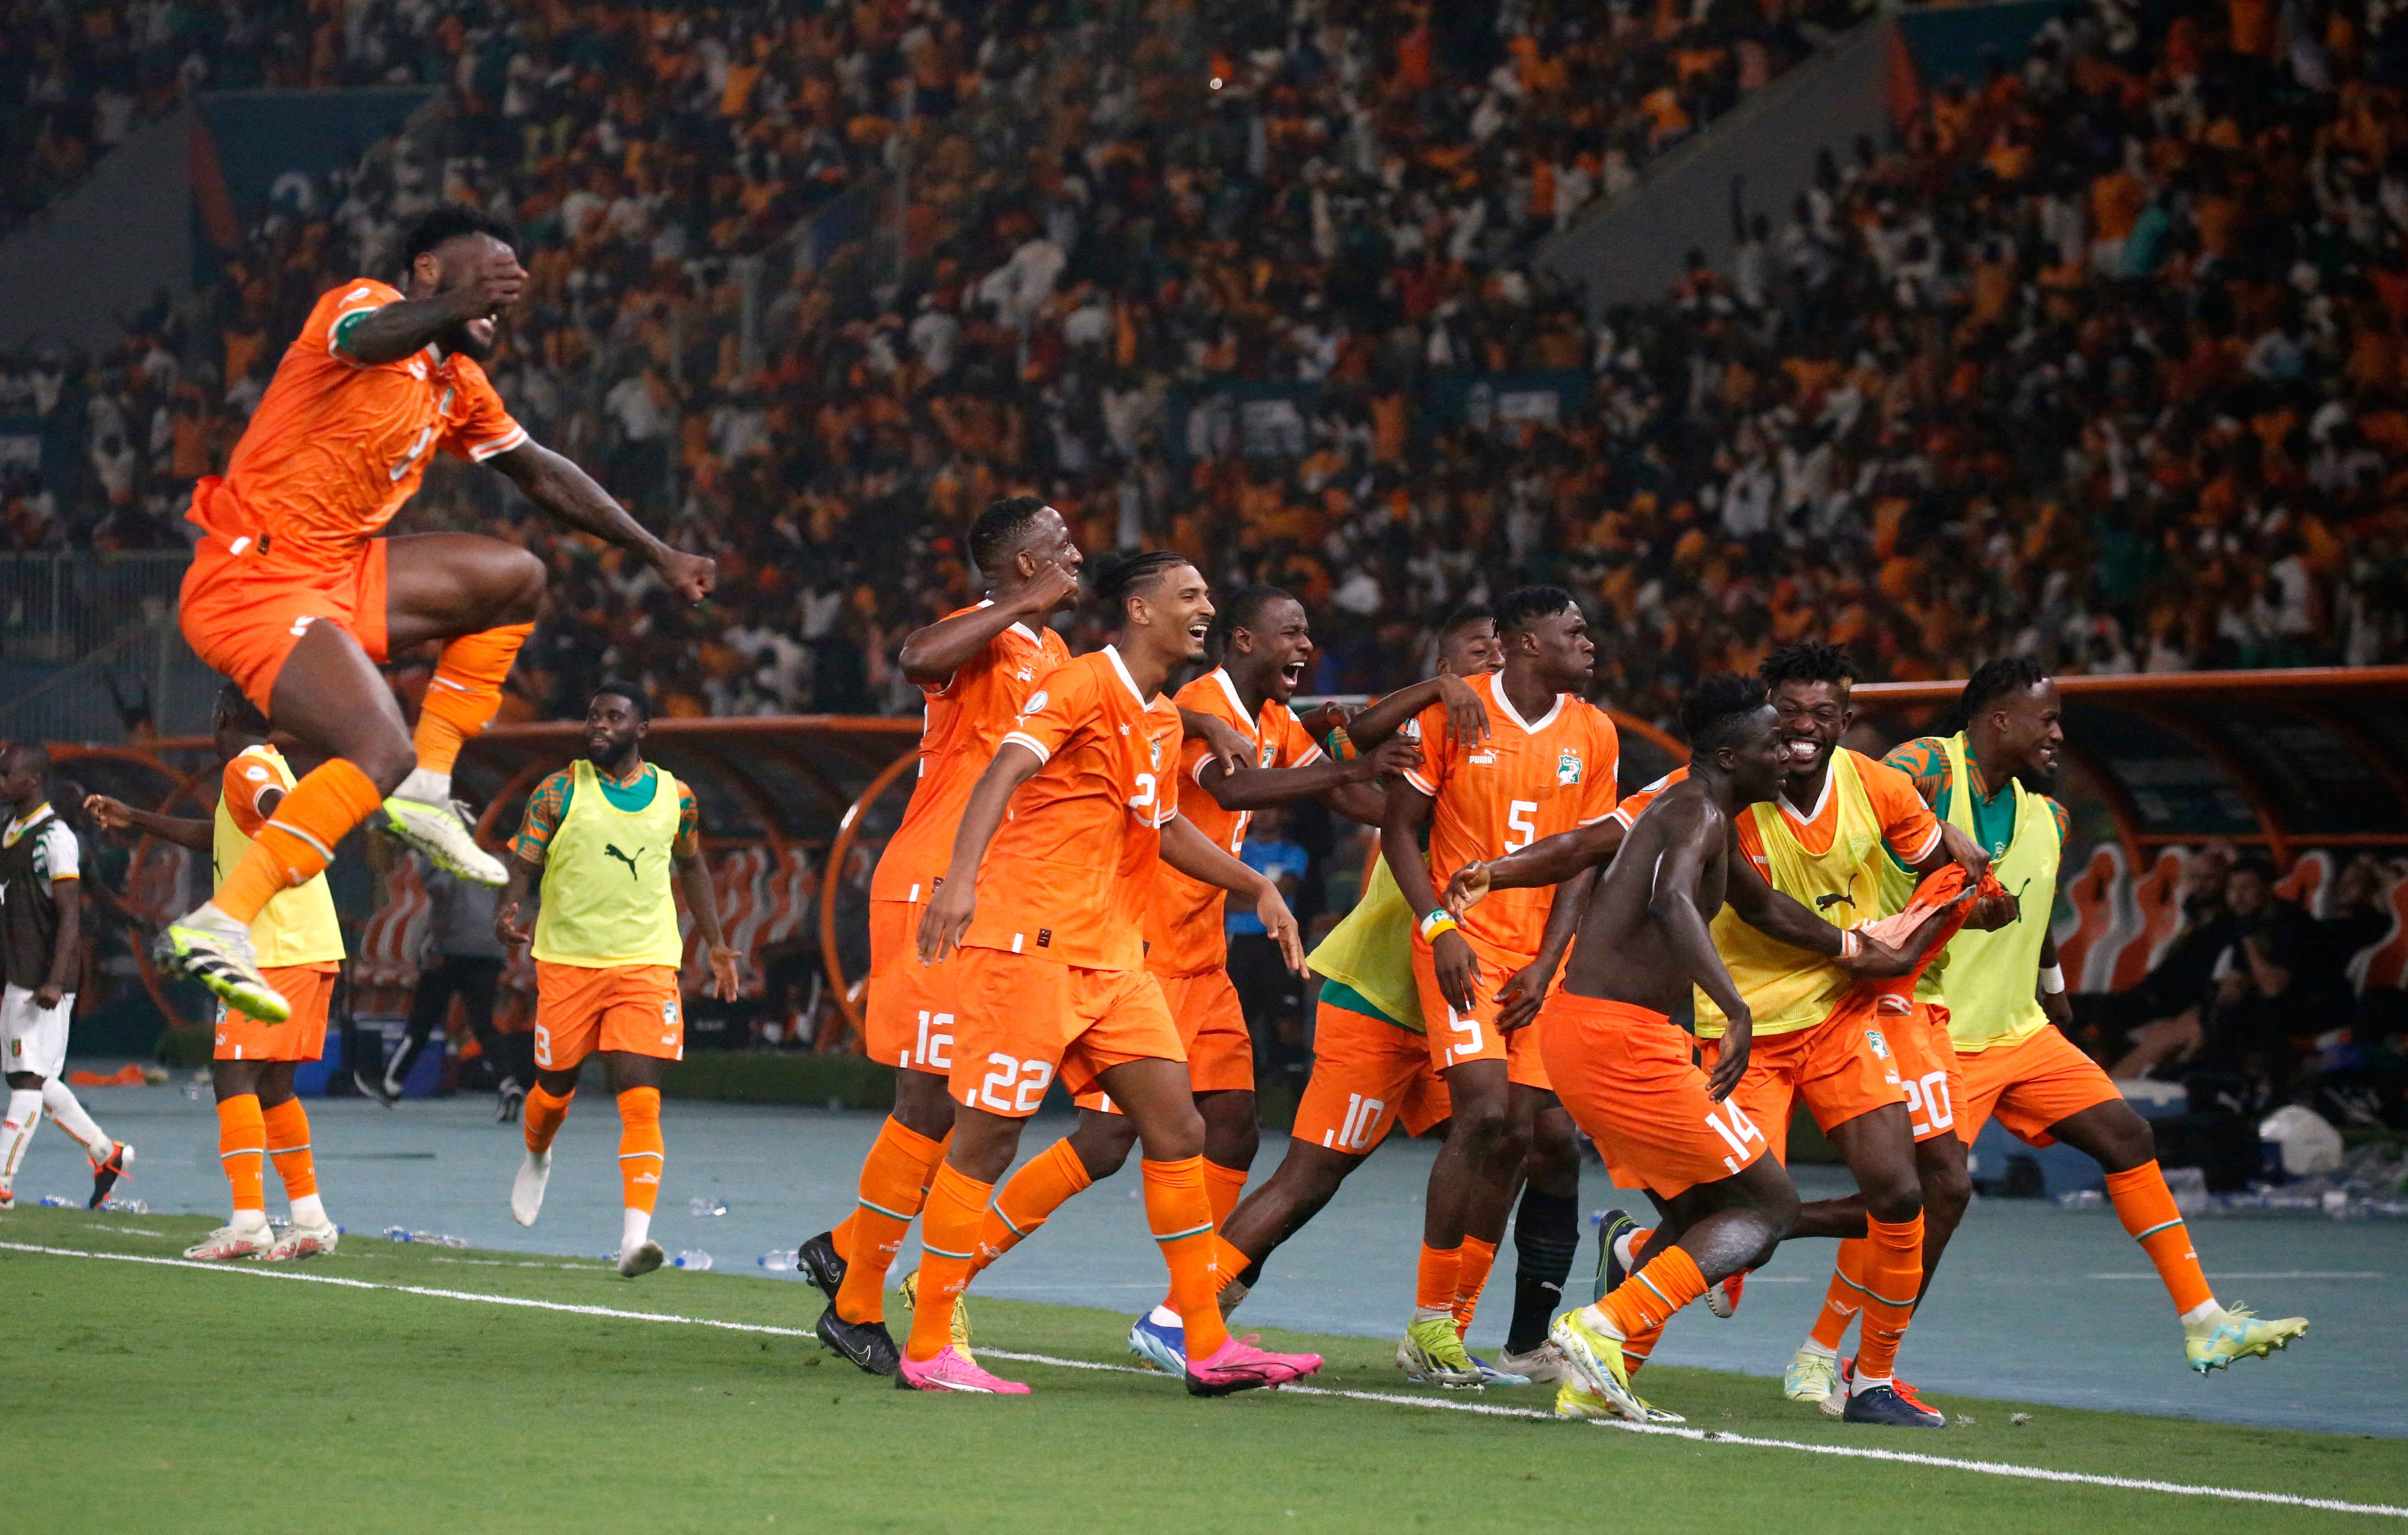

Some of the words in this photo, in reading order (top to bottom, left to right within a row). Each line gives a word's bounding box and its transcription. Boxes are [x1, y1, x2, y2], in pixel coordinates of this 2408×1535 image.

[1469, 755, 1493, 764] PUMA
[1505, 800, 1538, 853] 5
[916, 1010, 954, 1068] 12
[1449, 1001, 1483, 1055] 5
[981, 1052, 1053, 1111] 22
[1901, 1071, 1954, 1136] 20
[1338, 1093, 1384, 1149] 10
[1705, 1096, 1765, 1161] 14
